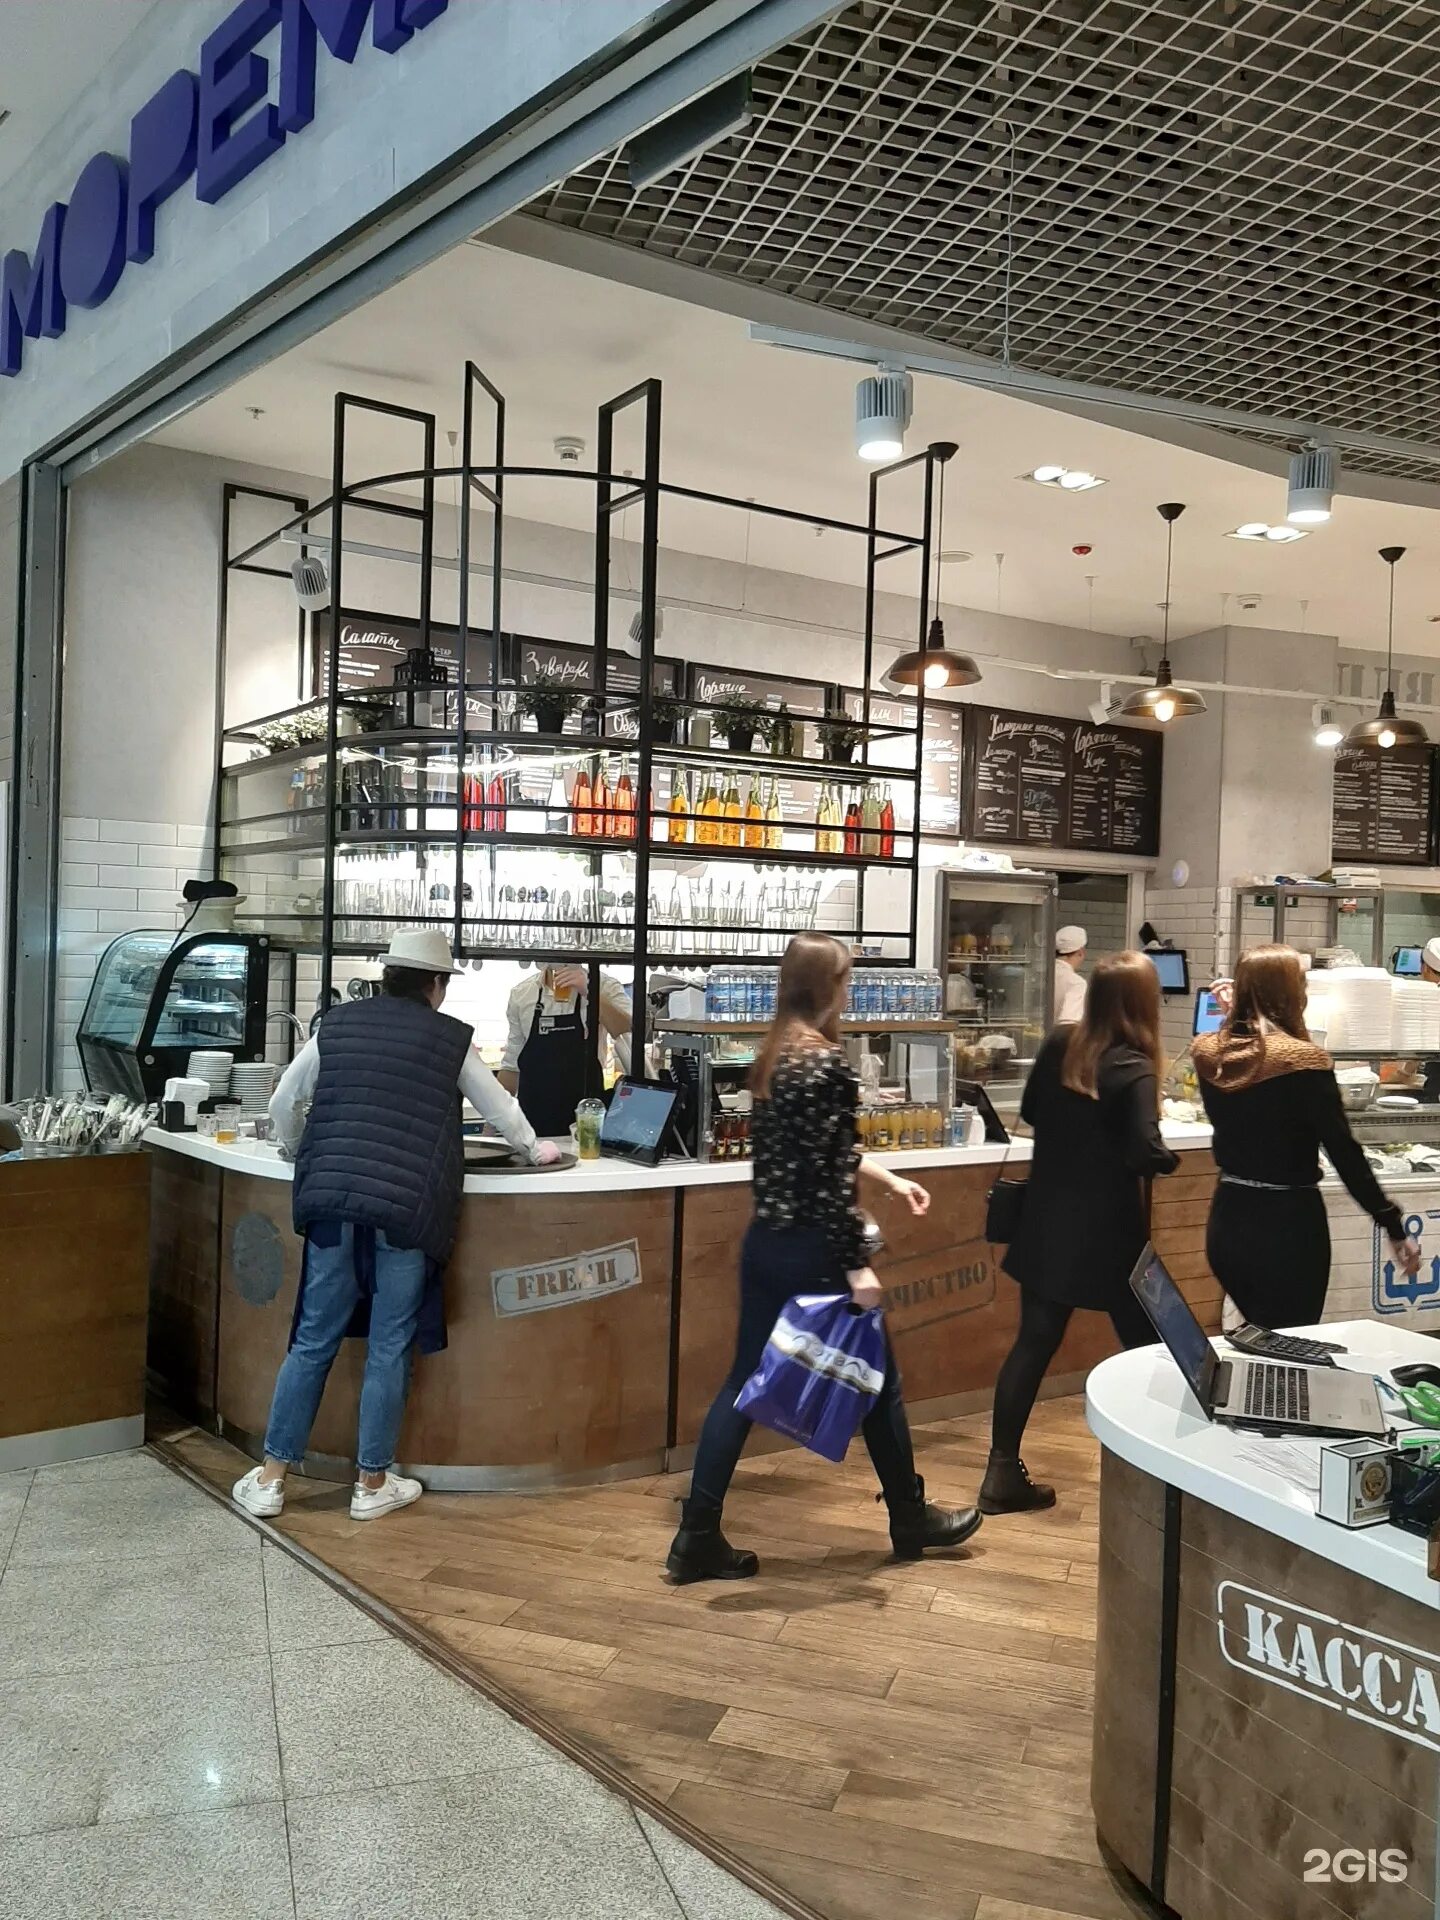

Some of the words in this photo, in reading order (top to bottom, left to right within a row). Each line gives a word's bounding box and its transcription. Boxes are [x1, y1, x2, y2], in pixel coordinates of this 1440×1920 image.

[0, 0, 447, 377] МОРЕМ
[340, 624, 406, 650] Салаты
[526, 651, 591, 682] Завтраки
[696, 676, 751, 702] Горячие
[878, 1261, 988, 1313] АЧЕСТВО
[1244, 1602, 1440, 1733] КАССА
